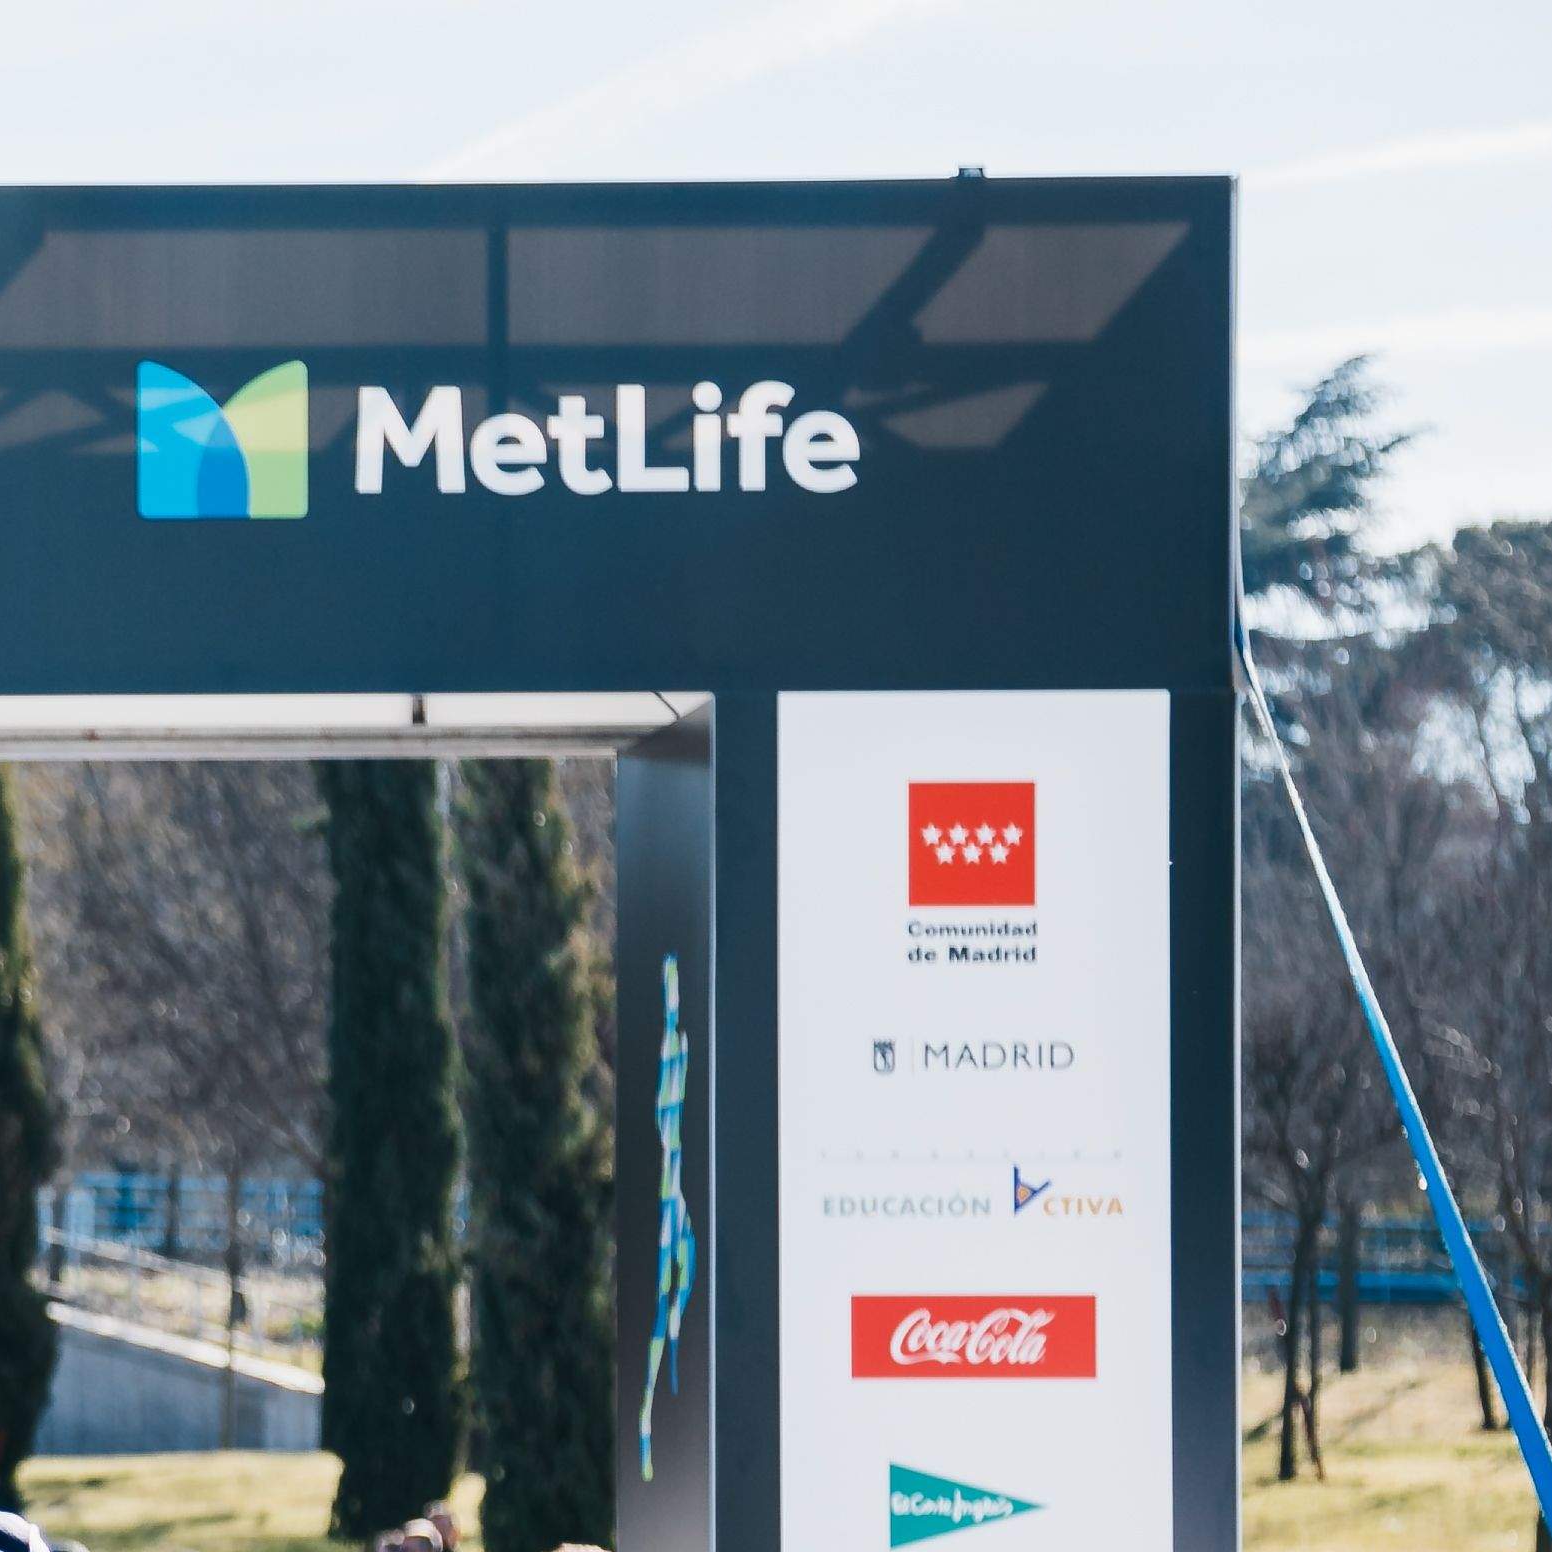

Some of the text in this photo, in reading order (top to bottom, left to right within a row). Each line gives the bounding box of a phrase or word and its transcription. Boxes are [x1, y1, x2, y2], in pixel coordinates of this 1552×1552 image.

[354, 380, 861, 496] MetLife
[907, 919, 1038, 938] Comunidad
[907, 945, 1038, 963] de Madrid
[924, 1041, 1075, 1071] MADRID
[822, 1191, 992, 1217] EDUCACIÓN
